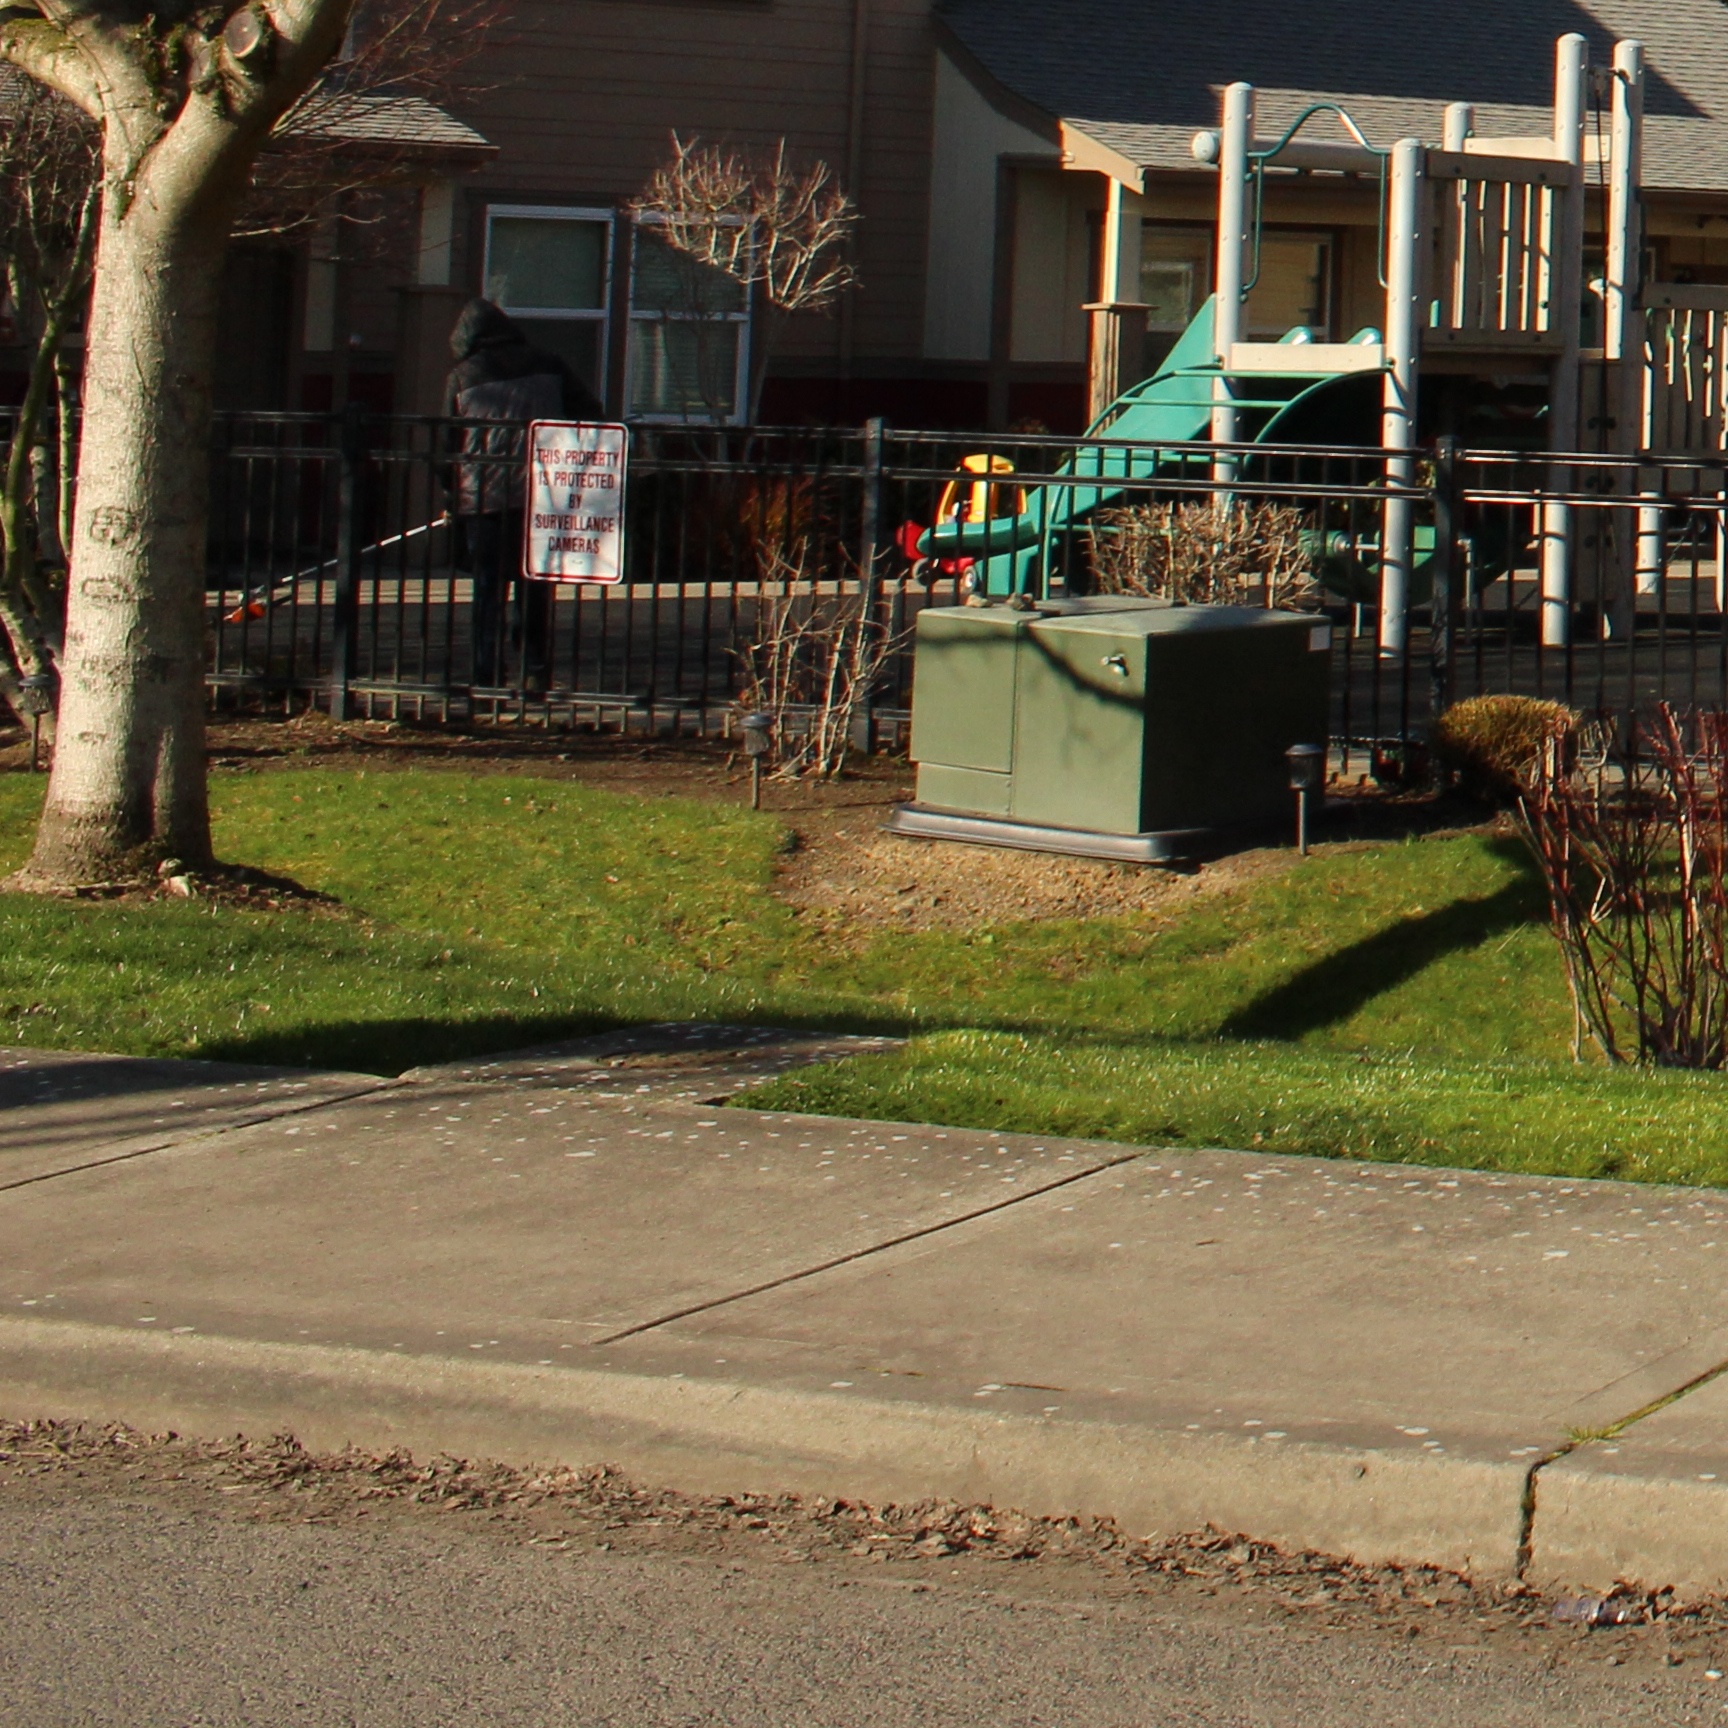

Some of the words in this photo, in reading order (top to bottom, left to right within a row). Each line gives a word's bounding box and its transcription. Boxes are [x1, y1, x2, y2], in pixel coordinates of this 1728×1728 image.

[536, 448, 560, 464] THIS
[565, 450, 619, 468] PROPERTY
[538, 471, 549, 486] IS
[554, 472, 614, 489] PROTECTED
[569, 493, 582, 509] BY
[535, 514, 615, 533] SURVEILLANCE
[548, 536, 600, 554] CAMERAS
